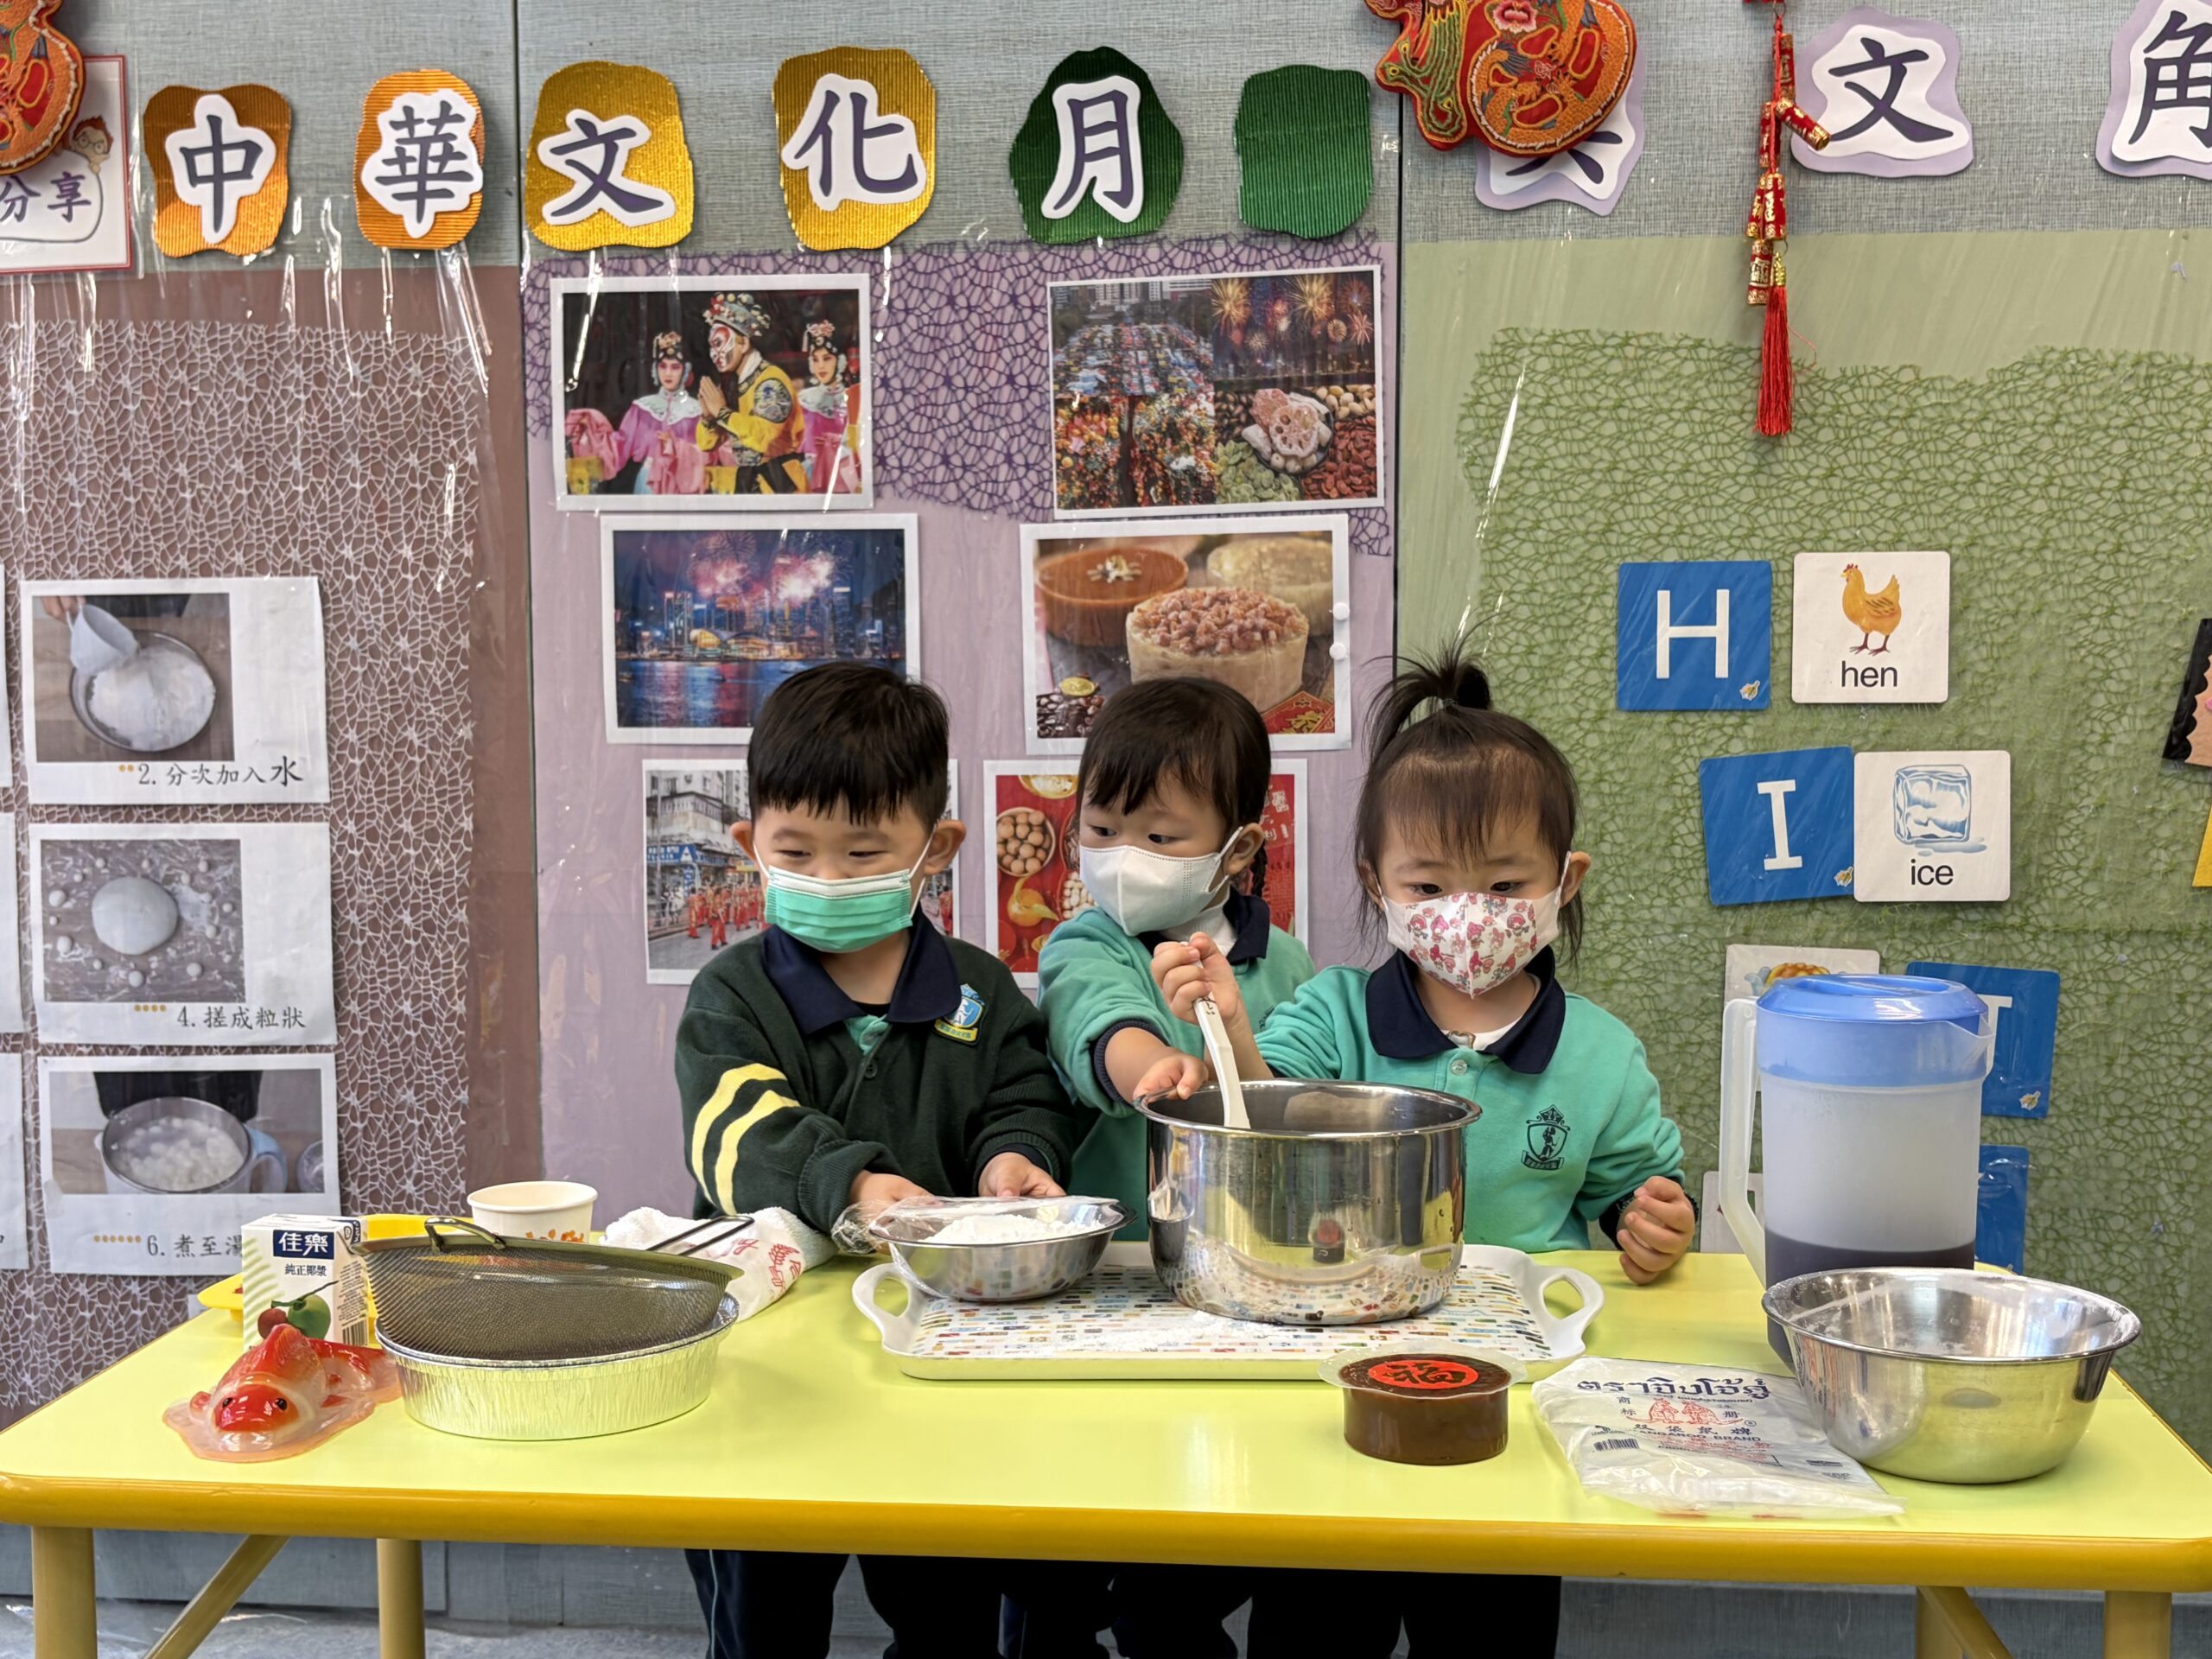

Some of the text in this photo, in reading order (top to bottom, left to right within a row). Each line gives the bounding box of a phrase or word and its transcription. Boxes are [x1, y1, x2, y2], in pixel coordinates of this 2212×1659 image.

[1656, 588, 1730, 679] H
[1840, 660, 1898, 688] hen
[1757, 779, 1803, 871] I
[1910, 858, 1954, 887] ice
[278, 1231, 328, 1256] 佳樂
